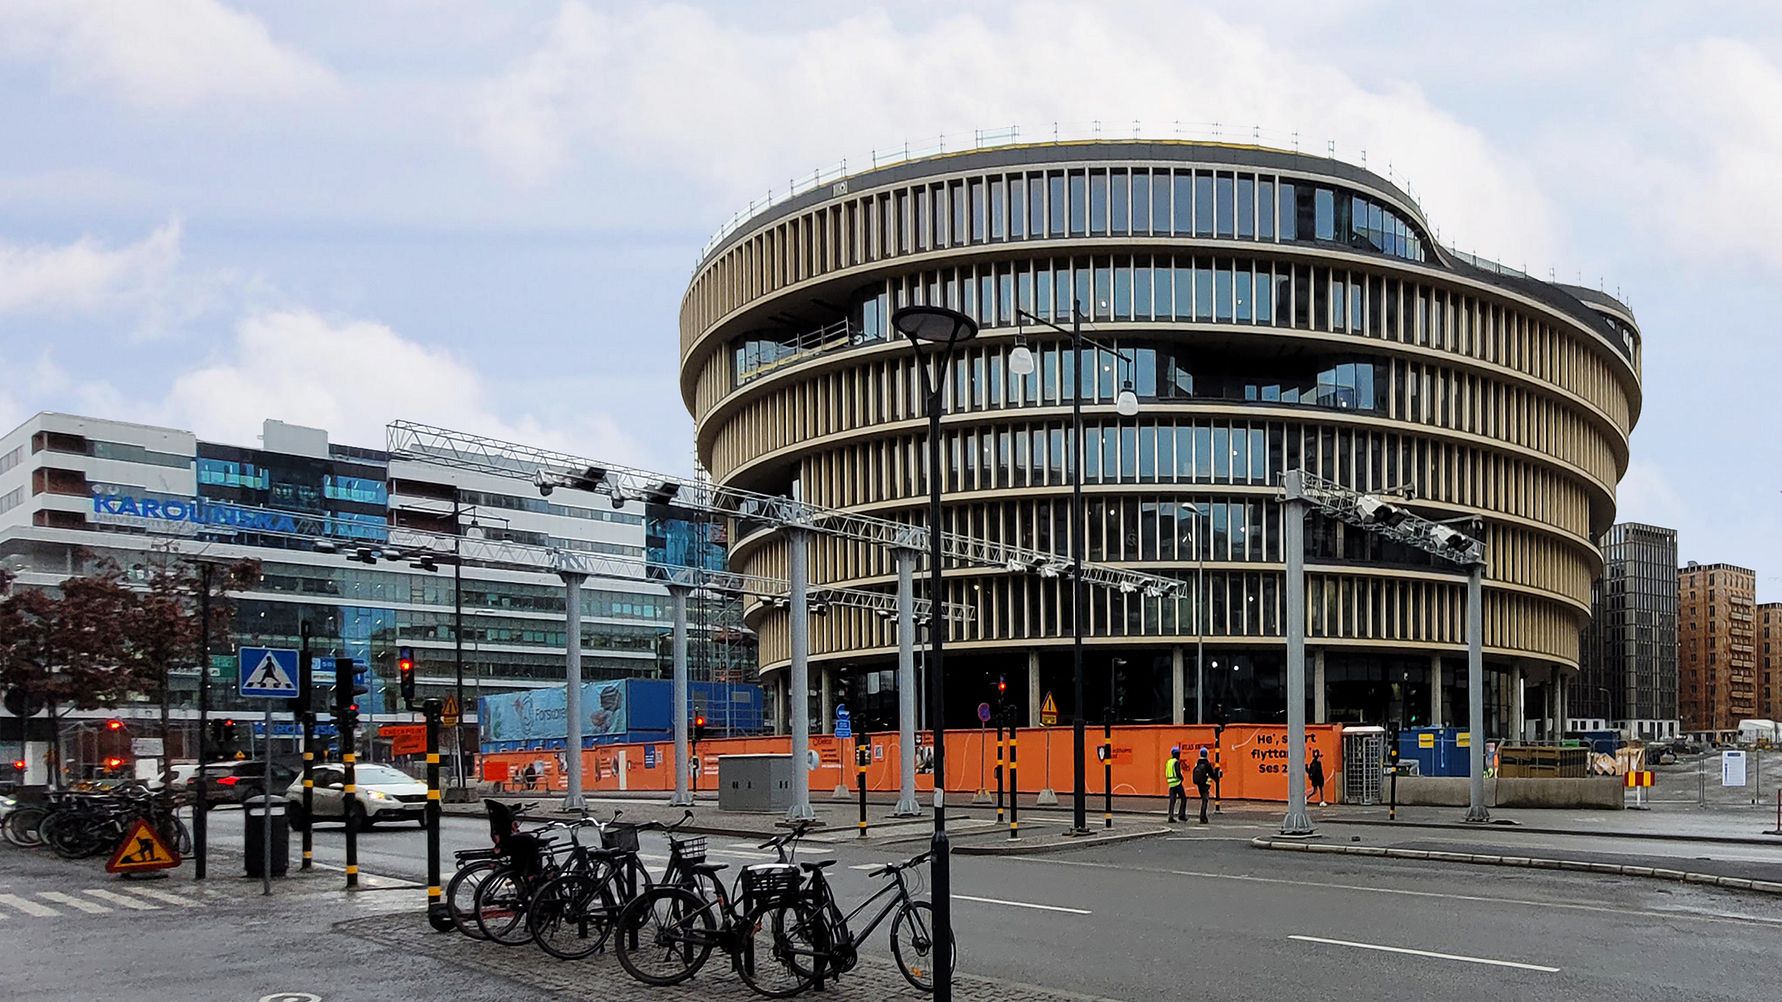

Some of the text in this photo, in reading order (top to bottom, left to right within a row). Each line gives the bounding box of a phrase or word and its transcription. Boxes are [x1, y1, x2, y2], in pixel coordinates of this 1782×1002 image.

[94, 493, 297, 533] KAROLINSKA
[535, 707, 567, 721] Forskare
[1257, 733, 1317, 745] He, srt
[1251, 748, 1289, 762] flytta
[1258, 763, 1279, 773] Ses
